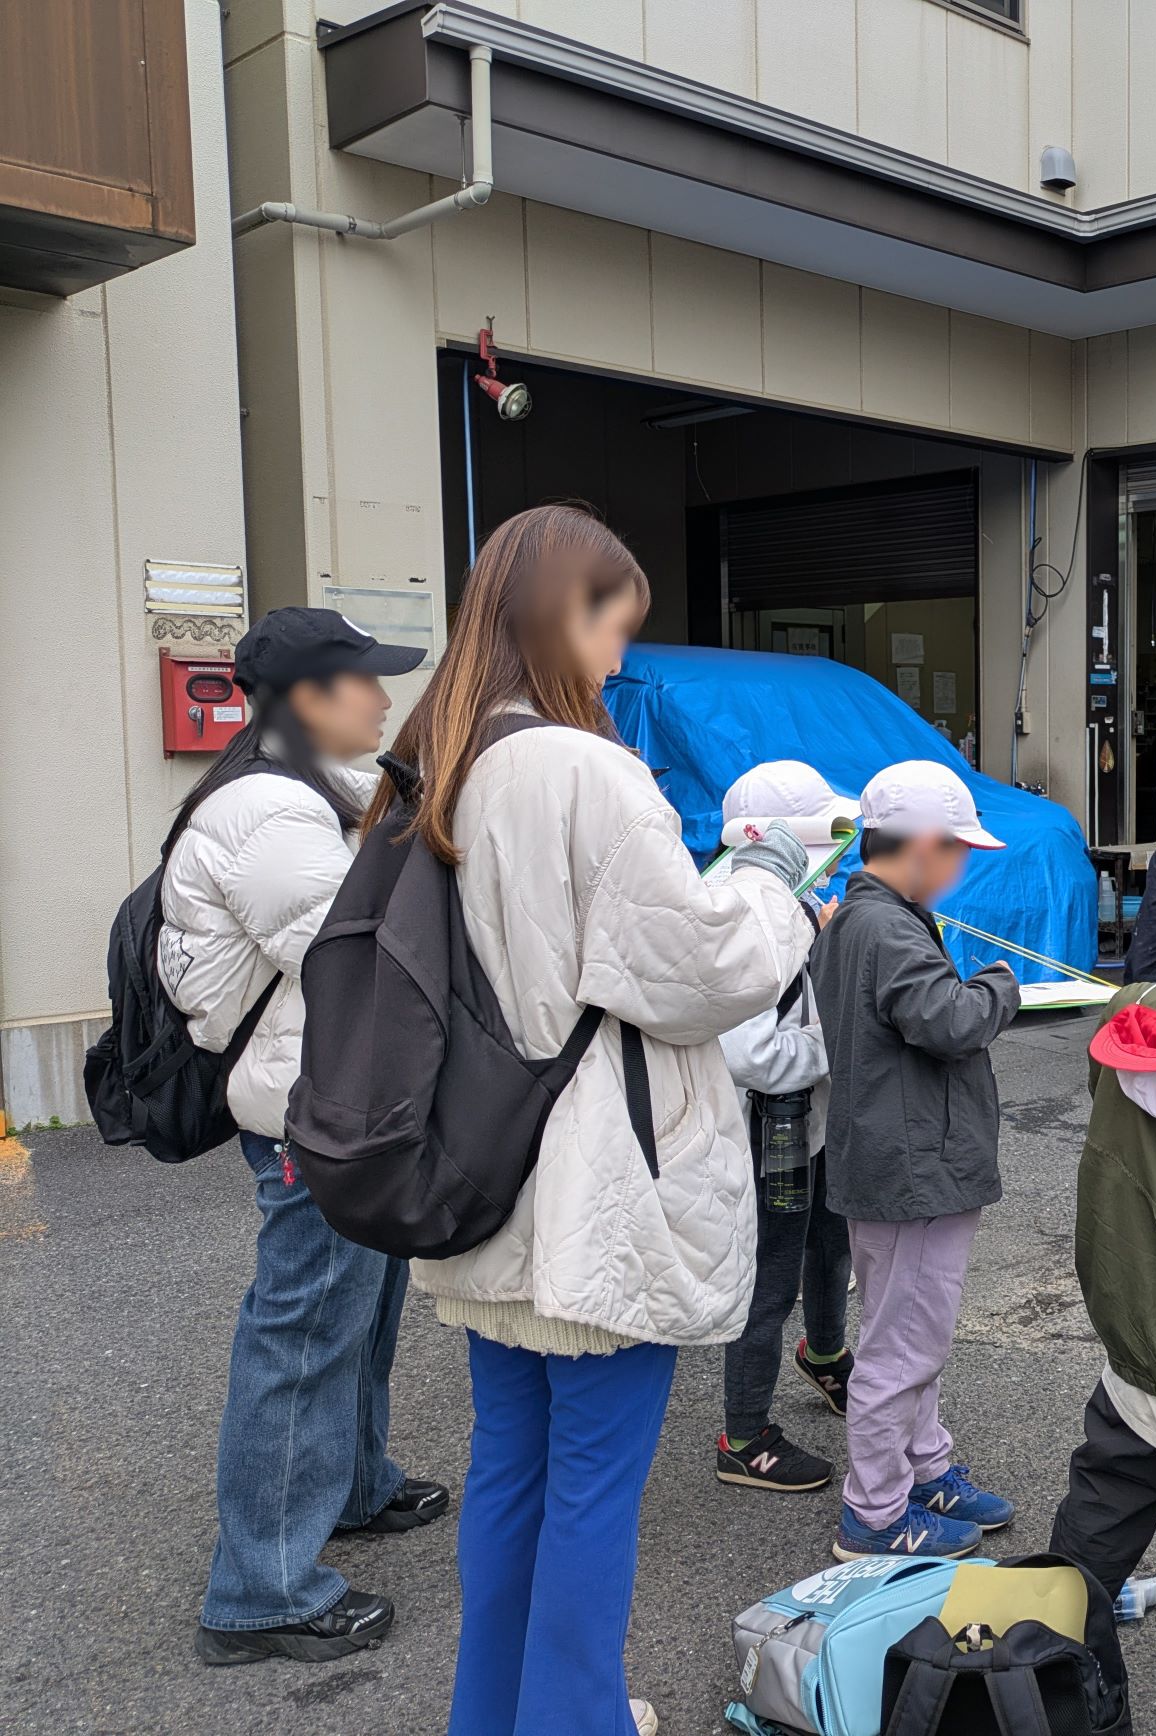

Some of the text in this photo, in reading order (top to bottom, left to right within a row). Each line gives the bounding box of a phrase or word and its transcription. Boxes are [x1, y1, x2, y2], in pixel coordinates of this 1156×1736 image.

[749, 1452, 780, 1474] N
[926, 1491, 960, 1513] N
[889, 1529, 929, 1553] N
[803, 1579, 852, 1605] THE
